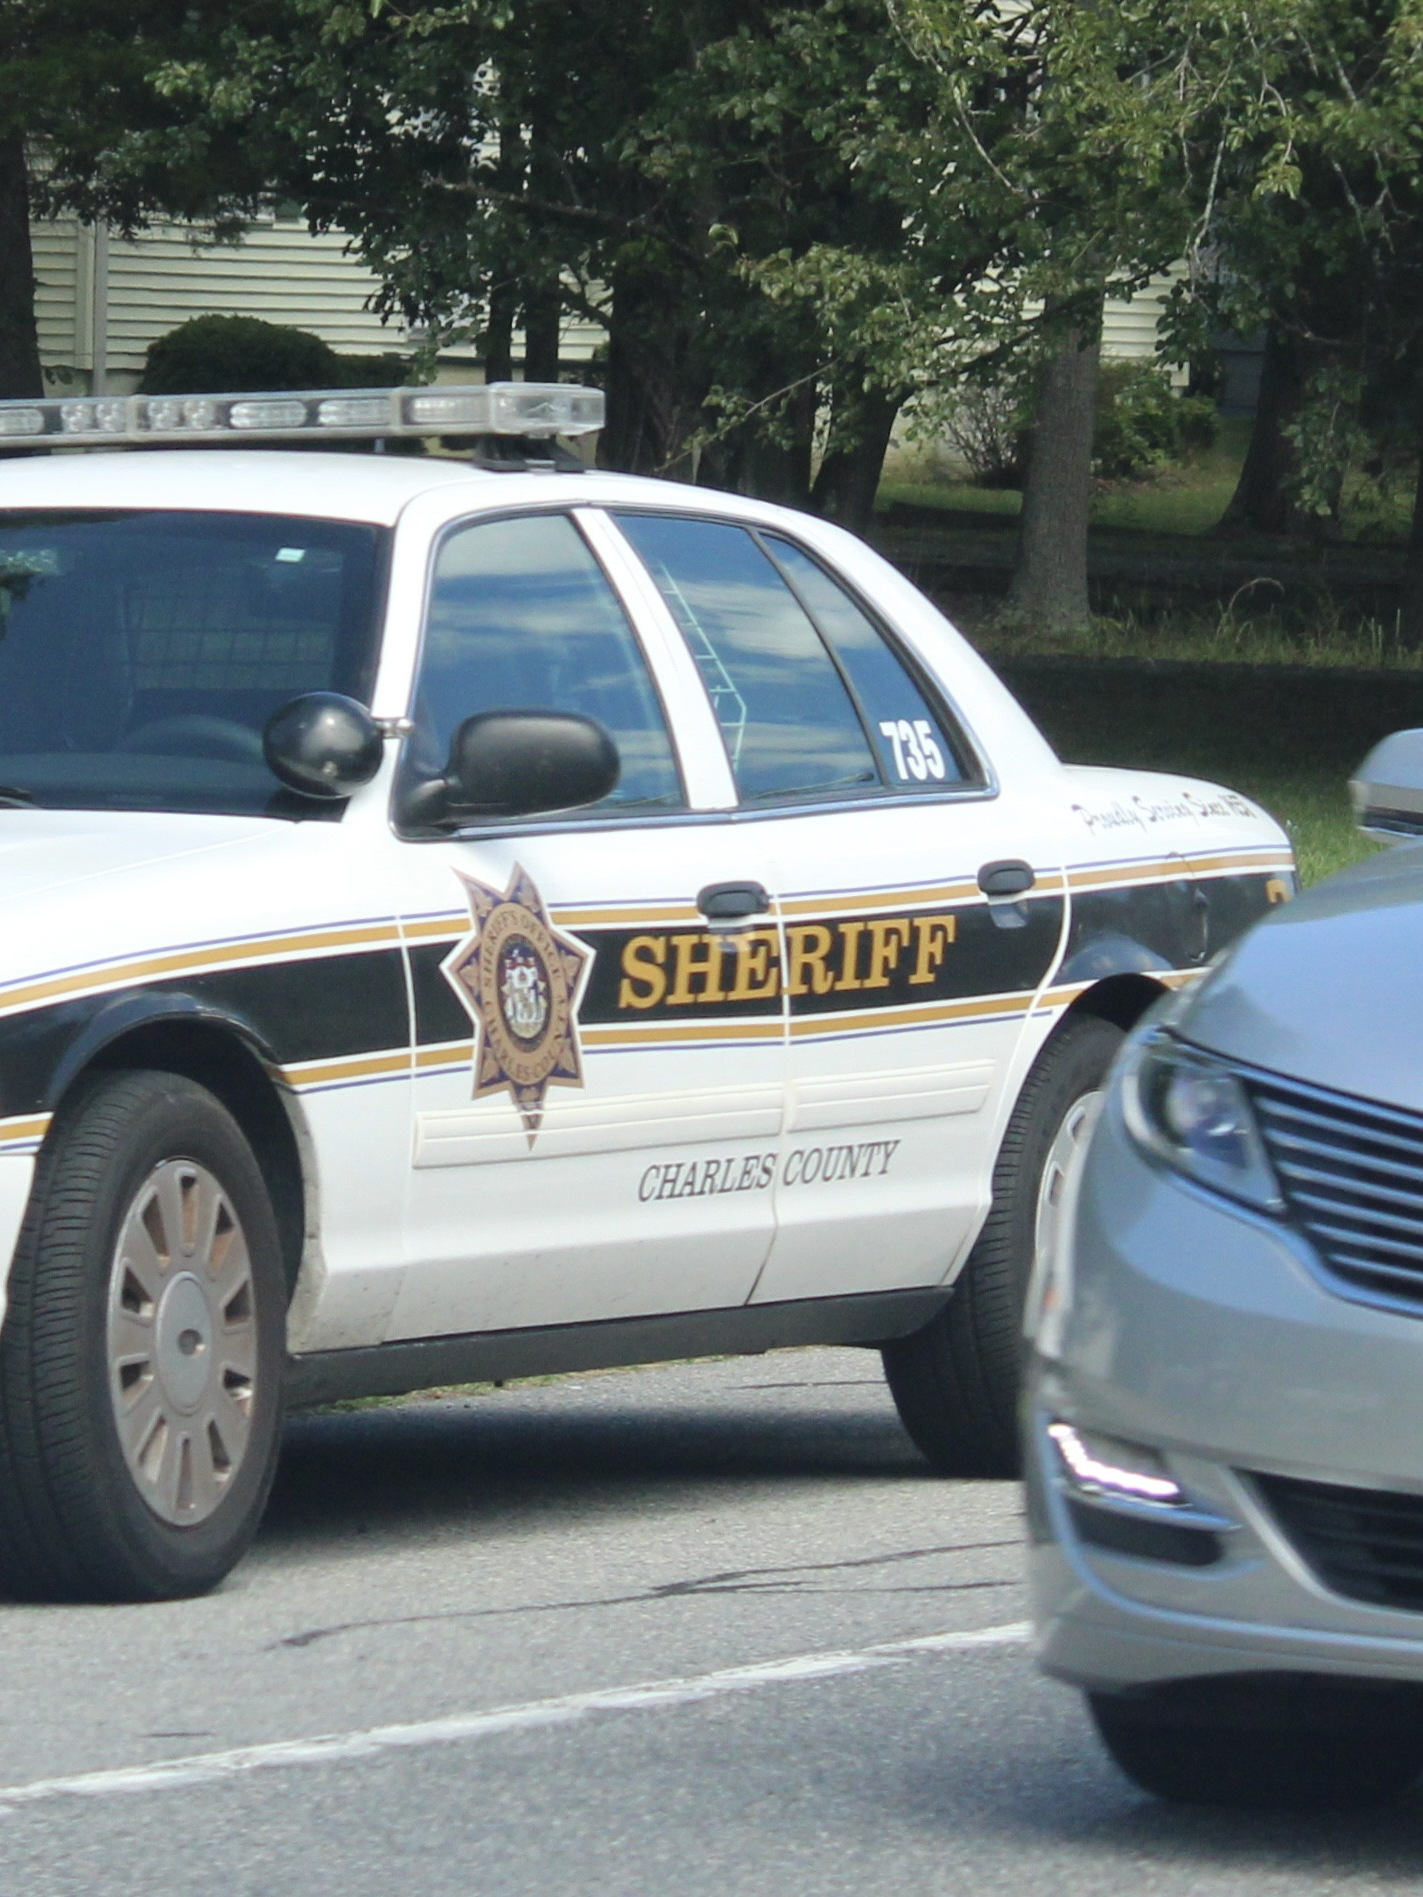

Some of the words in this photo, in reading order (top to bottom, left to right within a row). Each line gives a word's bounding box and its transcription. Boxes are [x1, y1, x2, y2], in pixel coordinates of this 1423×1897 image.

[879, 719, 945, 780] 735
[619, 914, 956, 1010] SHERIFF
[638, 1153, 777, 1202] CHARLES
[782, 1139, 901, 1187] COUNTY
